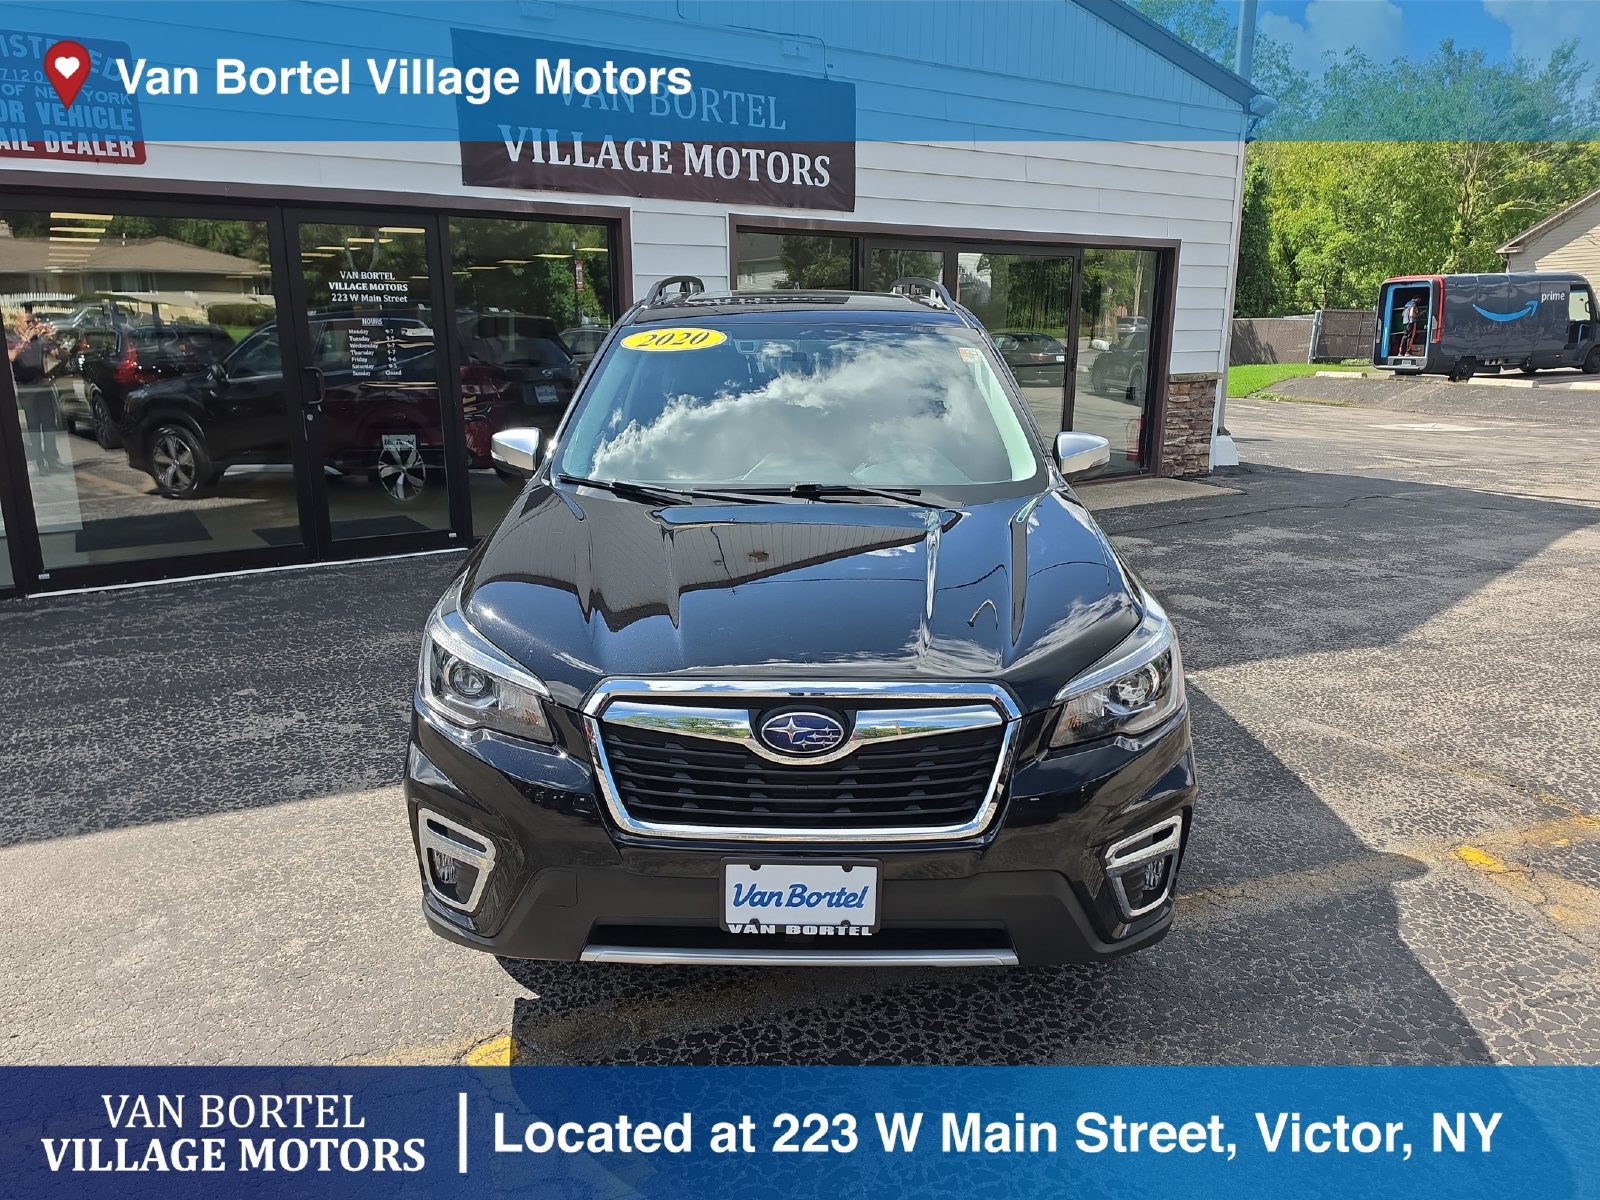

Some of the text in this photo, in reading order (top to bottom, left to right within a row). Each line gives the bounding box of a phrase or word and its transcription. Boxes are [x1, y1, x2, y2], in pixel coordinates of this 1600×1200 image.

[1, 83, 26, 97] OF
[81, 89, 133, 106] YORK
[553, 69, 786, 130] VAN BORTEL
[35, 101, 136, 131] VEHICLE
[43, 129, 136, 158] DEALER
[497, 123, 831, 188] VILLAGE MOTORS
[339, 270, 396, 281] VAN BORTEL
[328, 281, 409, 292] VILLAGE MOTORS
[331, 293, 408, 303] 223 W Main Street
[1541, 290, 1566, 304] prime
[637, 331, 710, 347] 2020
[727, 924, 873, 936] VAN BORTEL
